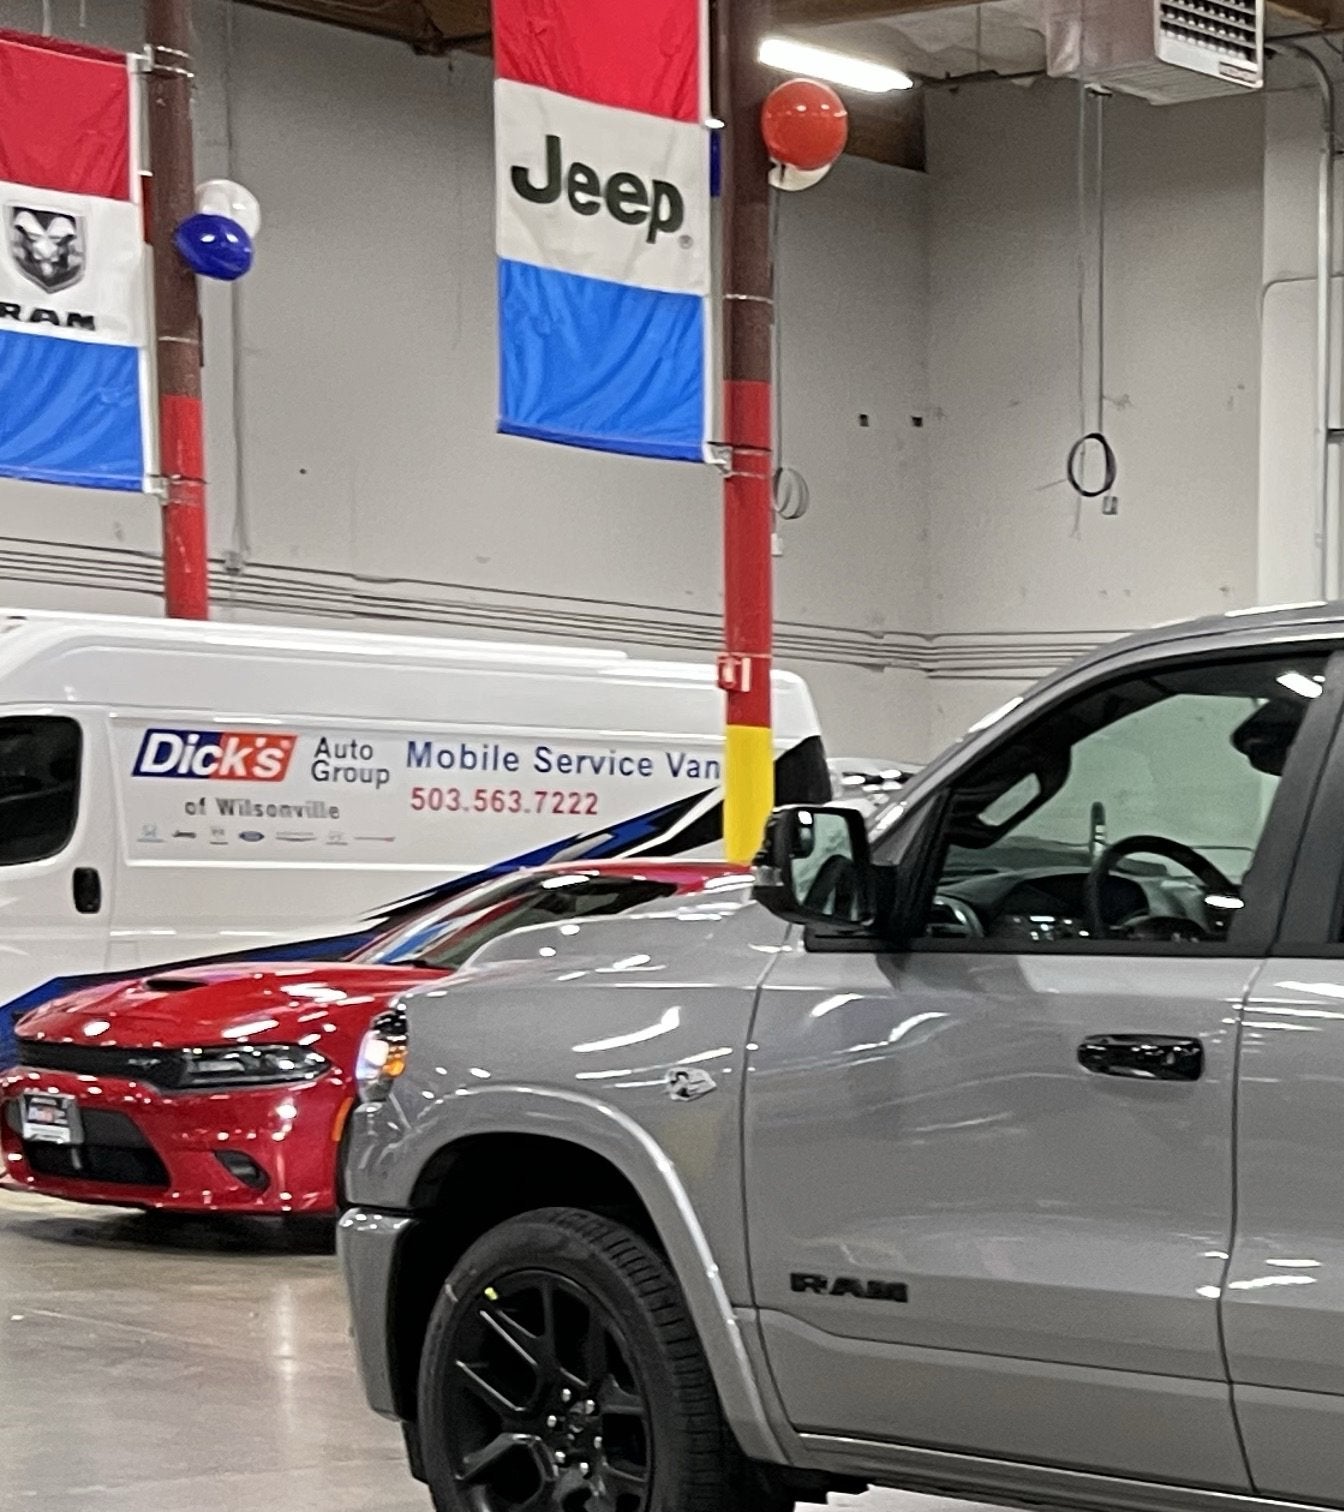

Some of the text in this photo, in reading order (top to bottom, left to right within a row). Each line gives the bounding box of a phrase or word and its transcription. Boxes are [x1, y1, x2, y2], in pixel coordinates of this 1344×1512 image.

[510, 134, 684, 244] Jeep
[0, 301, 96, 331] RAM
[140, 732, 285, 779] Dick's
[313, 737, 373, 761] Auto
[406, 740, 720, 779] Mobile Service Van
[310, 759, 390, 789] Group
[184, 798, 206, 816] of
[410, 786, 599, 815] 503.563.7222
[789, 1272, 909, 1304] RAM
